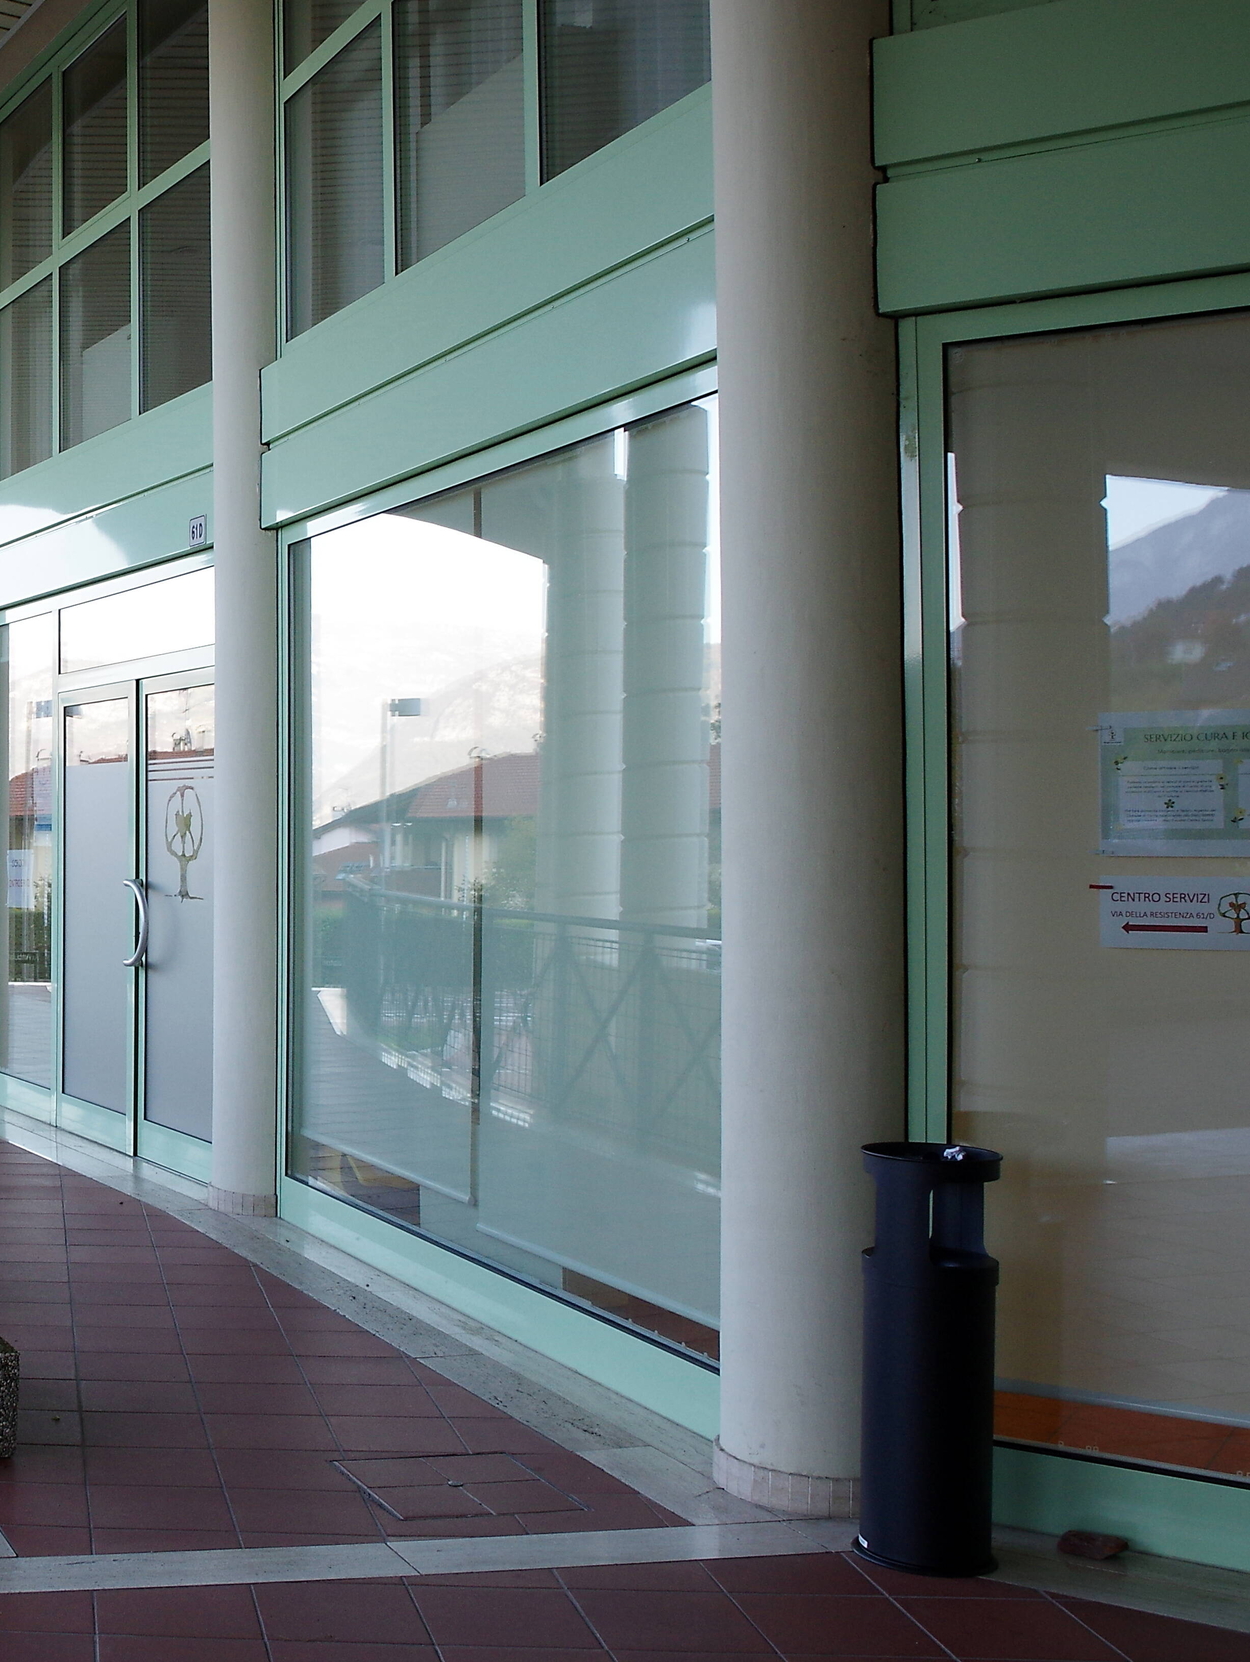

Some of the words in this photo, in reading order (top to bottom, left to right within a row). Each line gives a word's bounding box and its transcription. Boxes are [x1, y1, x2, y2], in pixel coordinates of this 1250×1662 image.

[191, 522, 204, 541] 61D
[1143, 732, 1193, 743] SERVIZIO
[1196, 731, 1229, 741] CURA
[1111, 891, 1161, 903] CENTRO
[1164, 892, 1210, 904] SERVIZI
[1110, 910, 1124, 918] VIA
[1125, 910, 1148, 918] DELLA
[1150, 911, 1195, 919] RESISTENZA
[1196, 912, 1215, 920] 61/D
